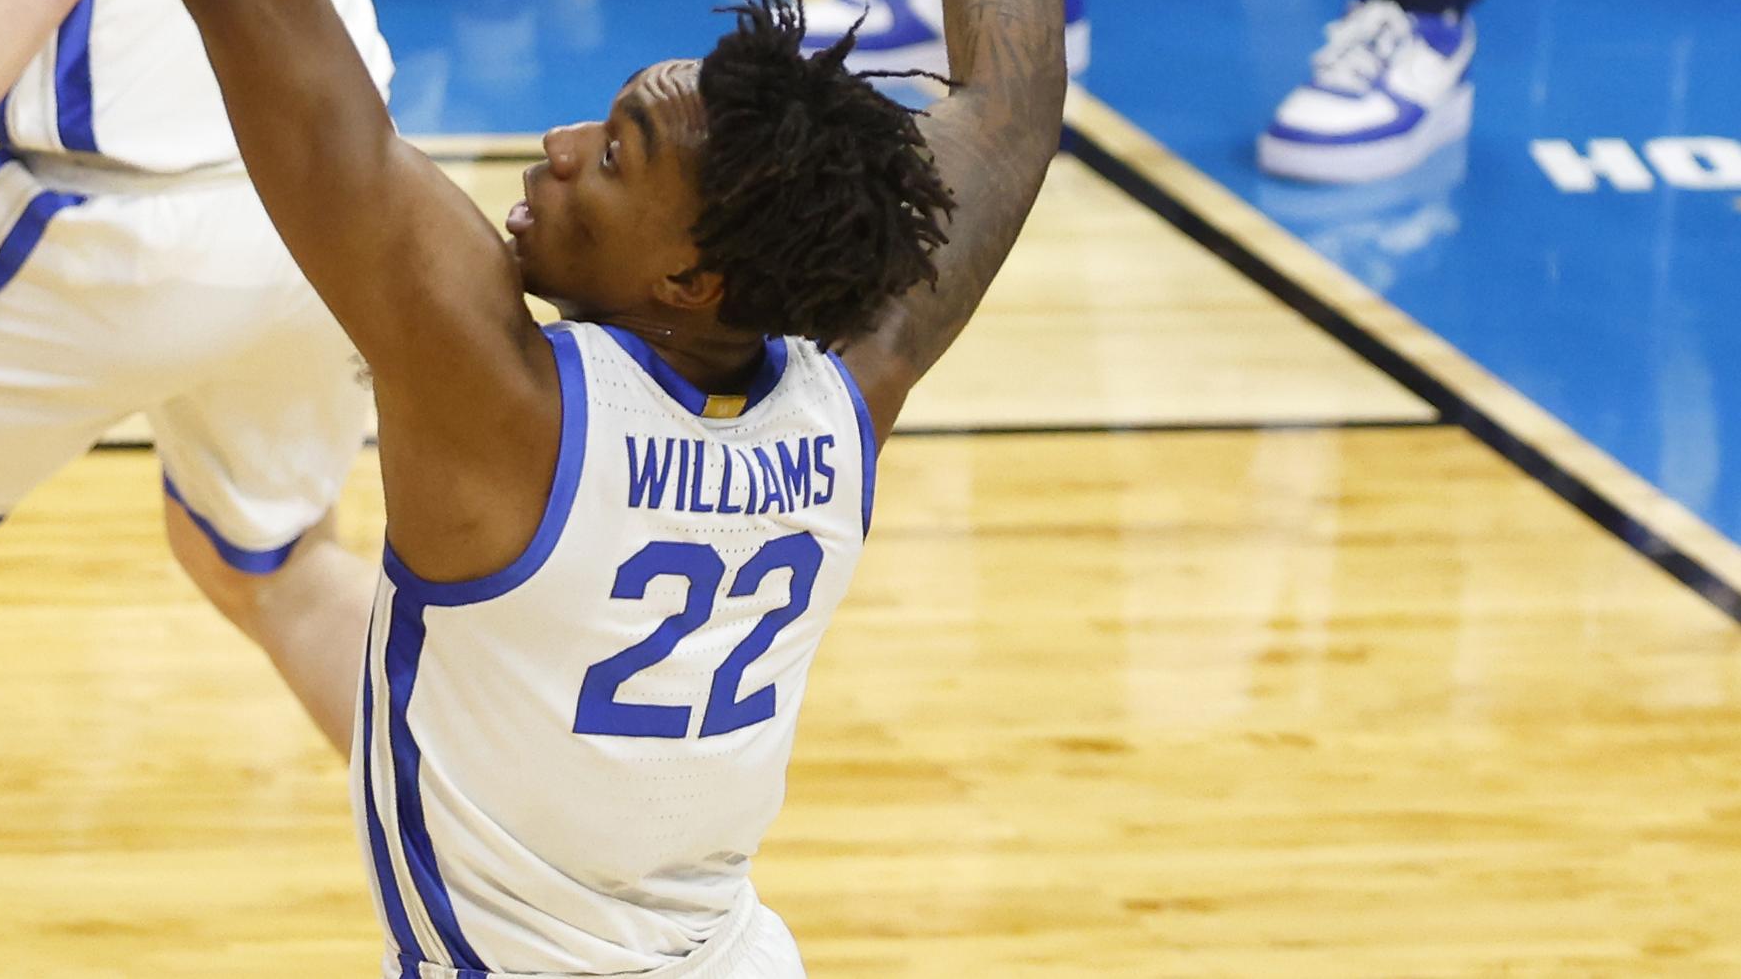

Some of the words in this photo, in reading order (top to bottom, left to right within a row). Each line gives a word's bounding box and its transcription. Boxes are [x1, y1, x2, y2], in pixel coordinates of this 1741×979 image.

[1530, 136, 1741, 192] HO
[626, 434, 835, 515] WILLIAMS
[572, 530, 824, 739] 22
